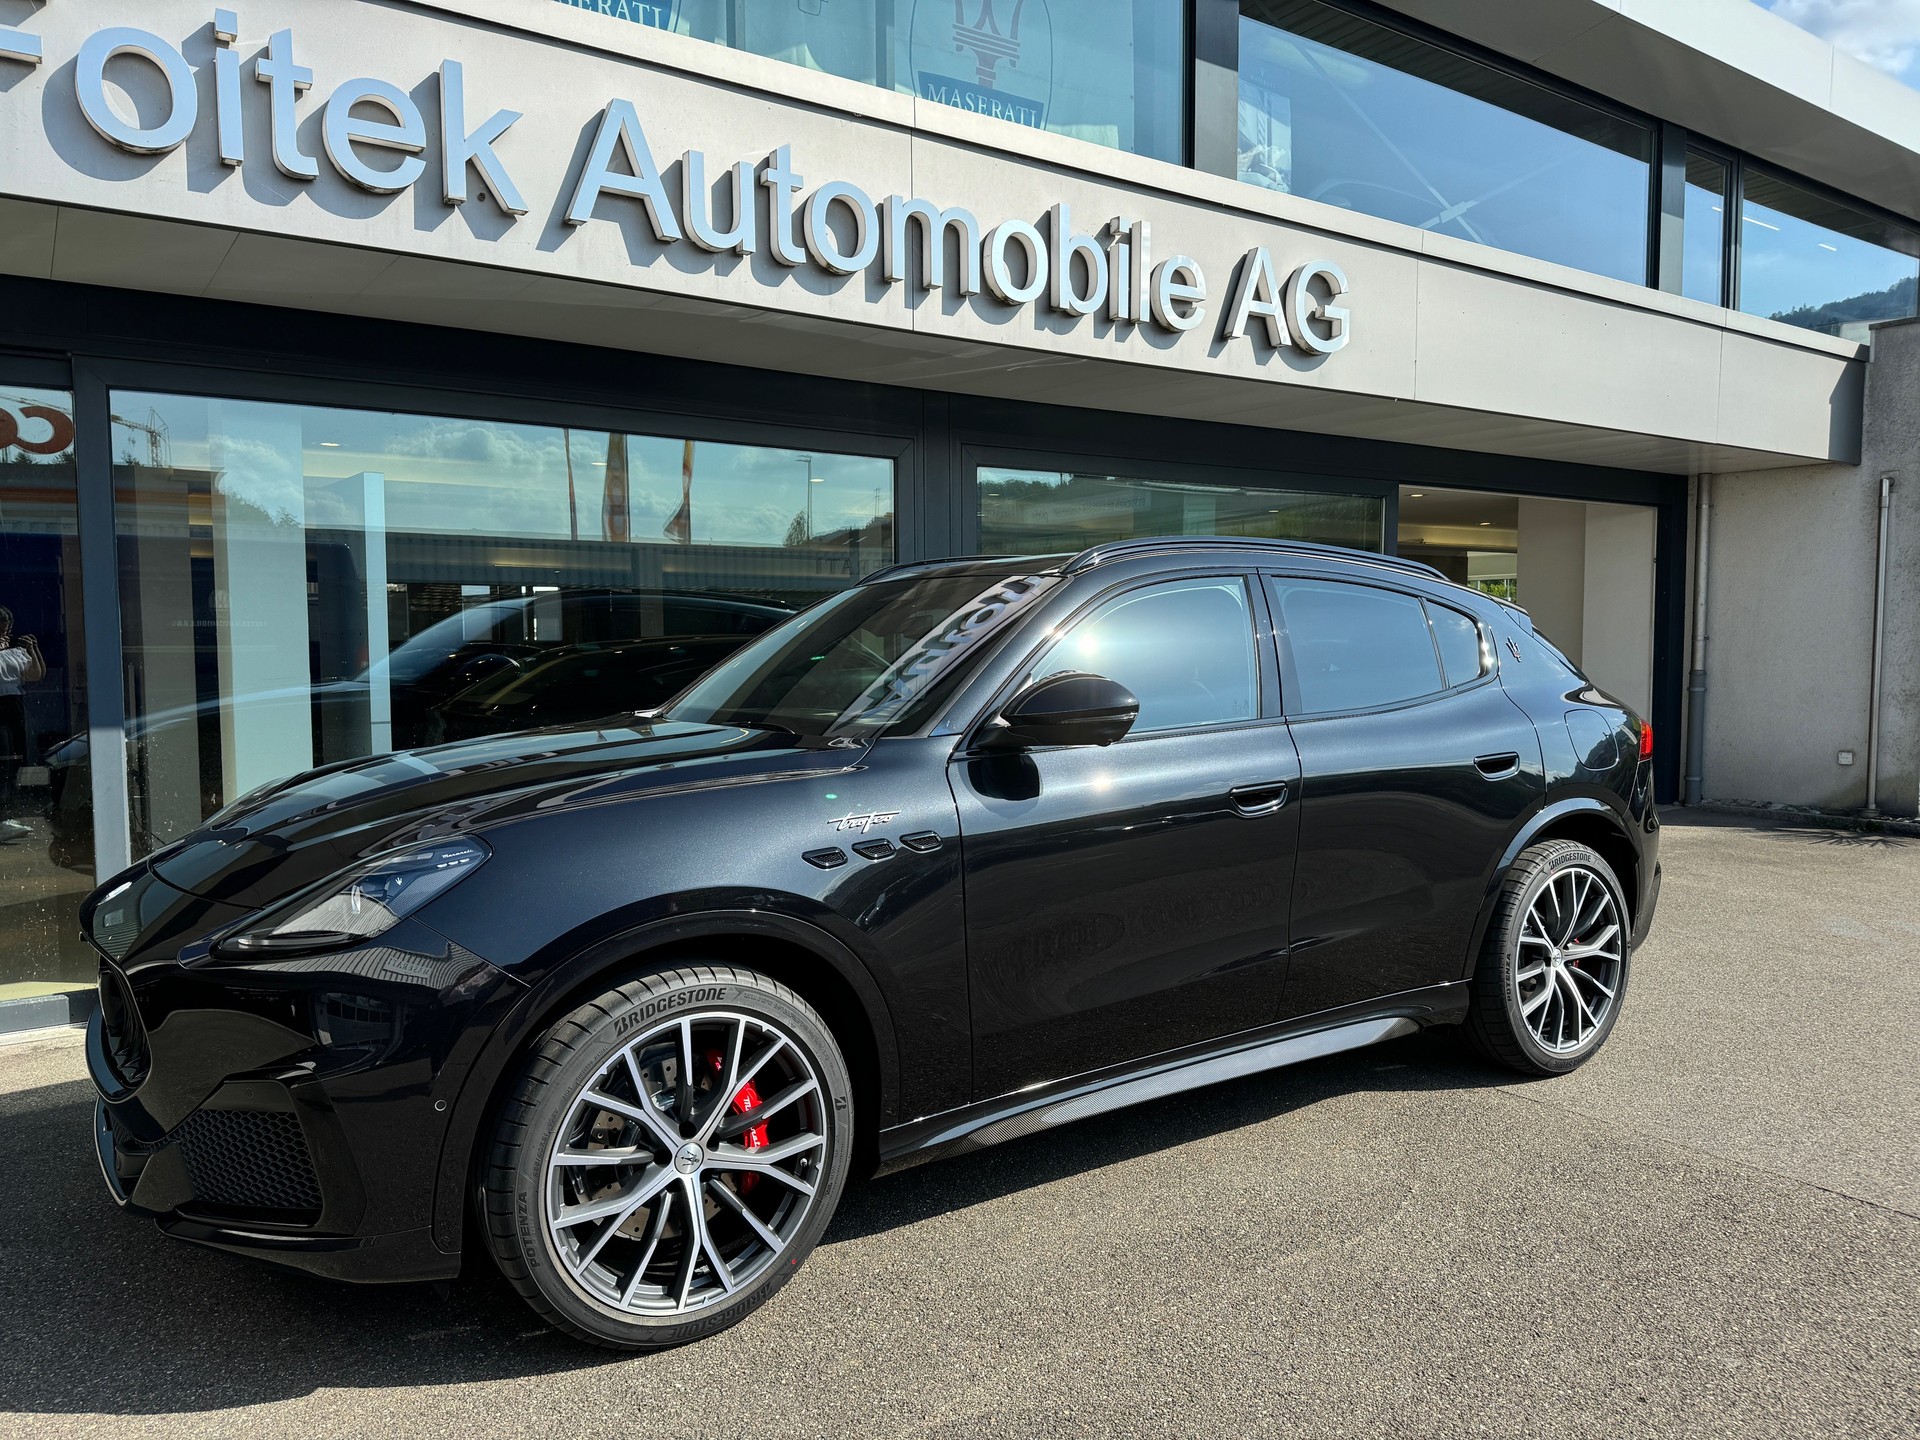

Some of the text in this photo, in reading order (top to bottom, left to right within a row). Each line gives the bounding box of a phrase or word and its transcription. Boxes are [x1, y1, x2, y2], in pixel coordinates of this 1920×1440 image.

[559, 0, 662, 29] RATI
[927, 83, 1037, 128] MASERATI
[0, 8, 1350, 355] oitek Automobile AG
[1549, 853, 1591, 870] BRIDGESTONE
[613, 987, 727, 1028] BRIDGESTONE
[518, 1191, 541, 1268] POTENZA
